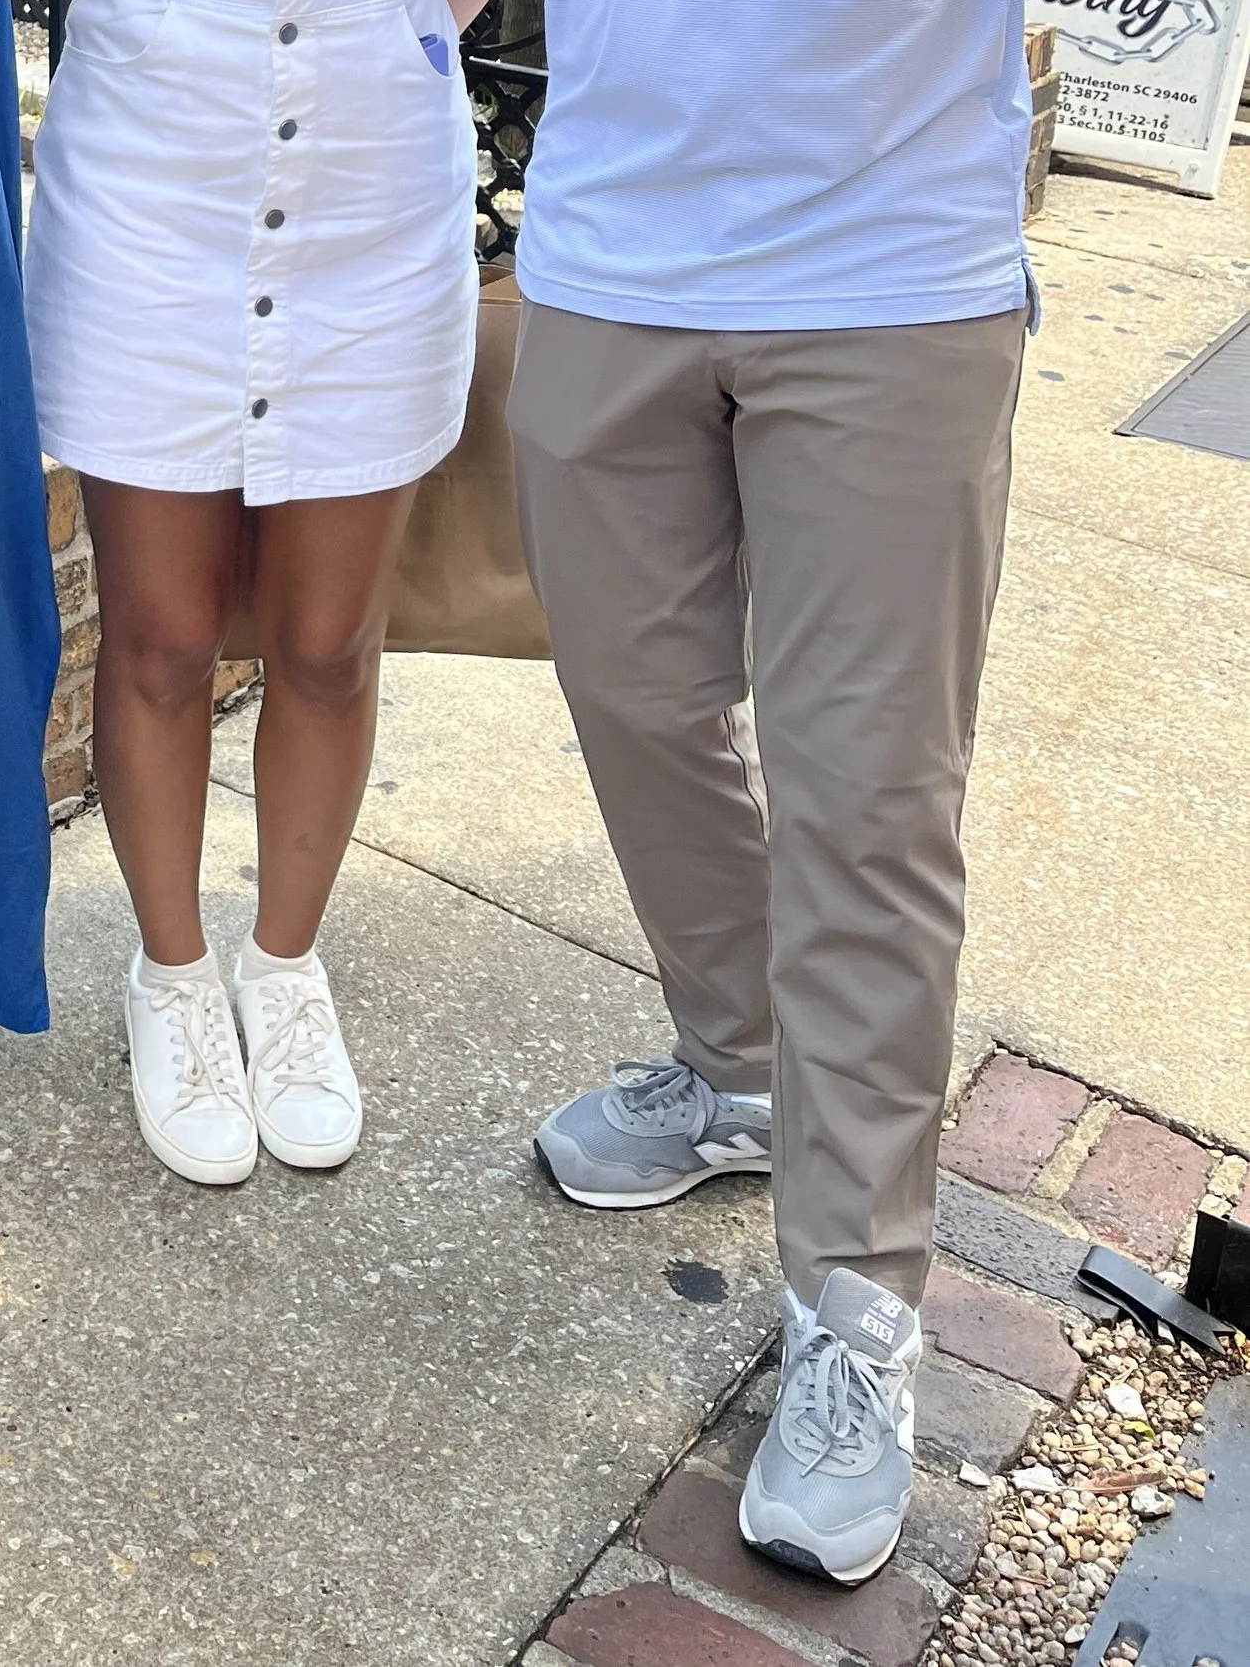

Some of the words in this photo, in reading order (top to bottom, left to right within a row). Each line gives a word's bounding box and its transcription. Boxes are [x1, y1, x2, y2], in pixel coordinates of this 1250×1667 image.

[1059, 85, 1109, 102] 2-3872
[1133, 84, 1151, 96] SC
[1153, 88, 1198, 104] 29406
[1107, 110, 1169, 130] 11-22-16
[865, 1318, 891, 1340] 515
